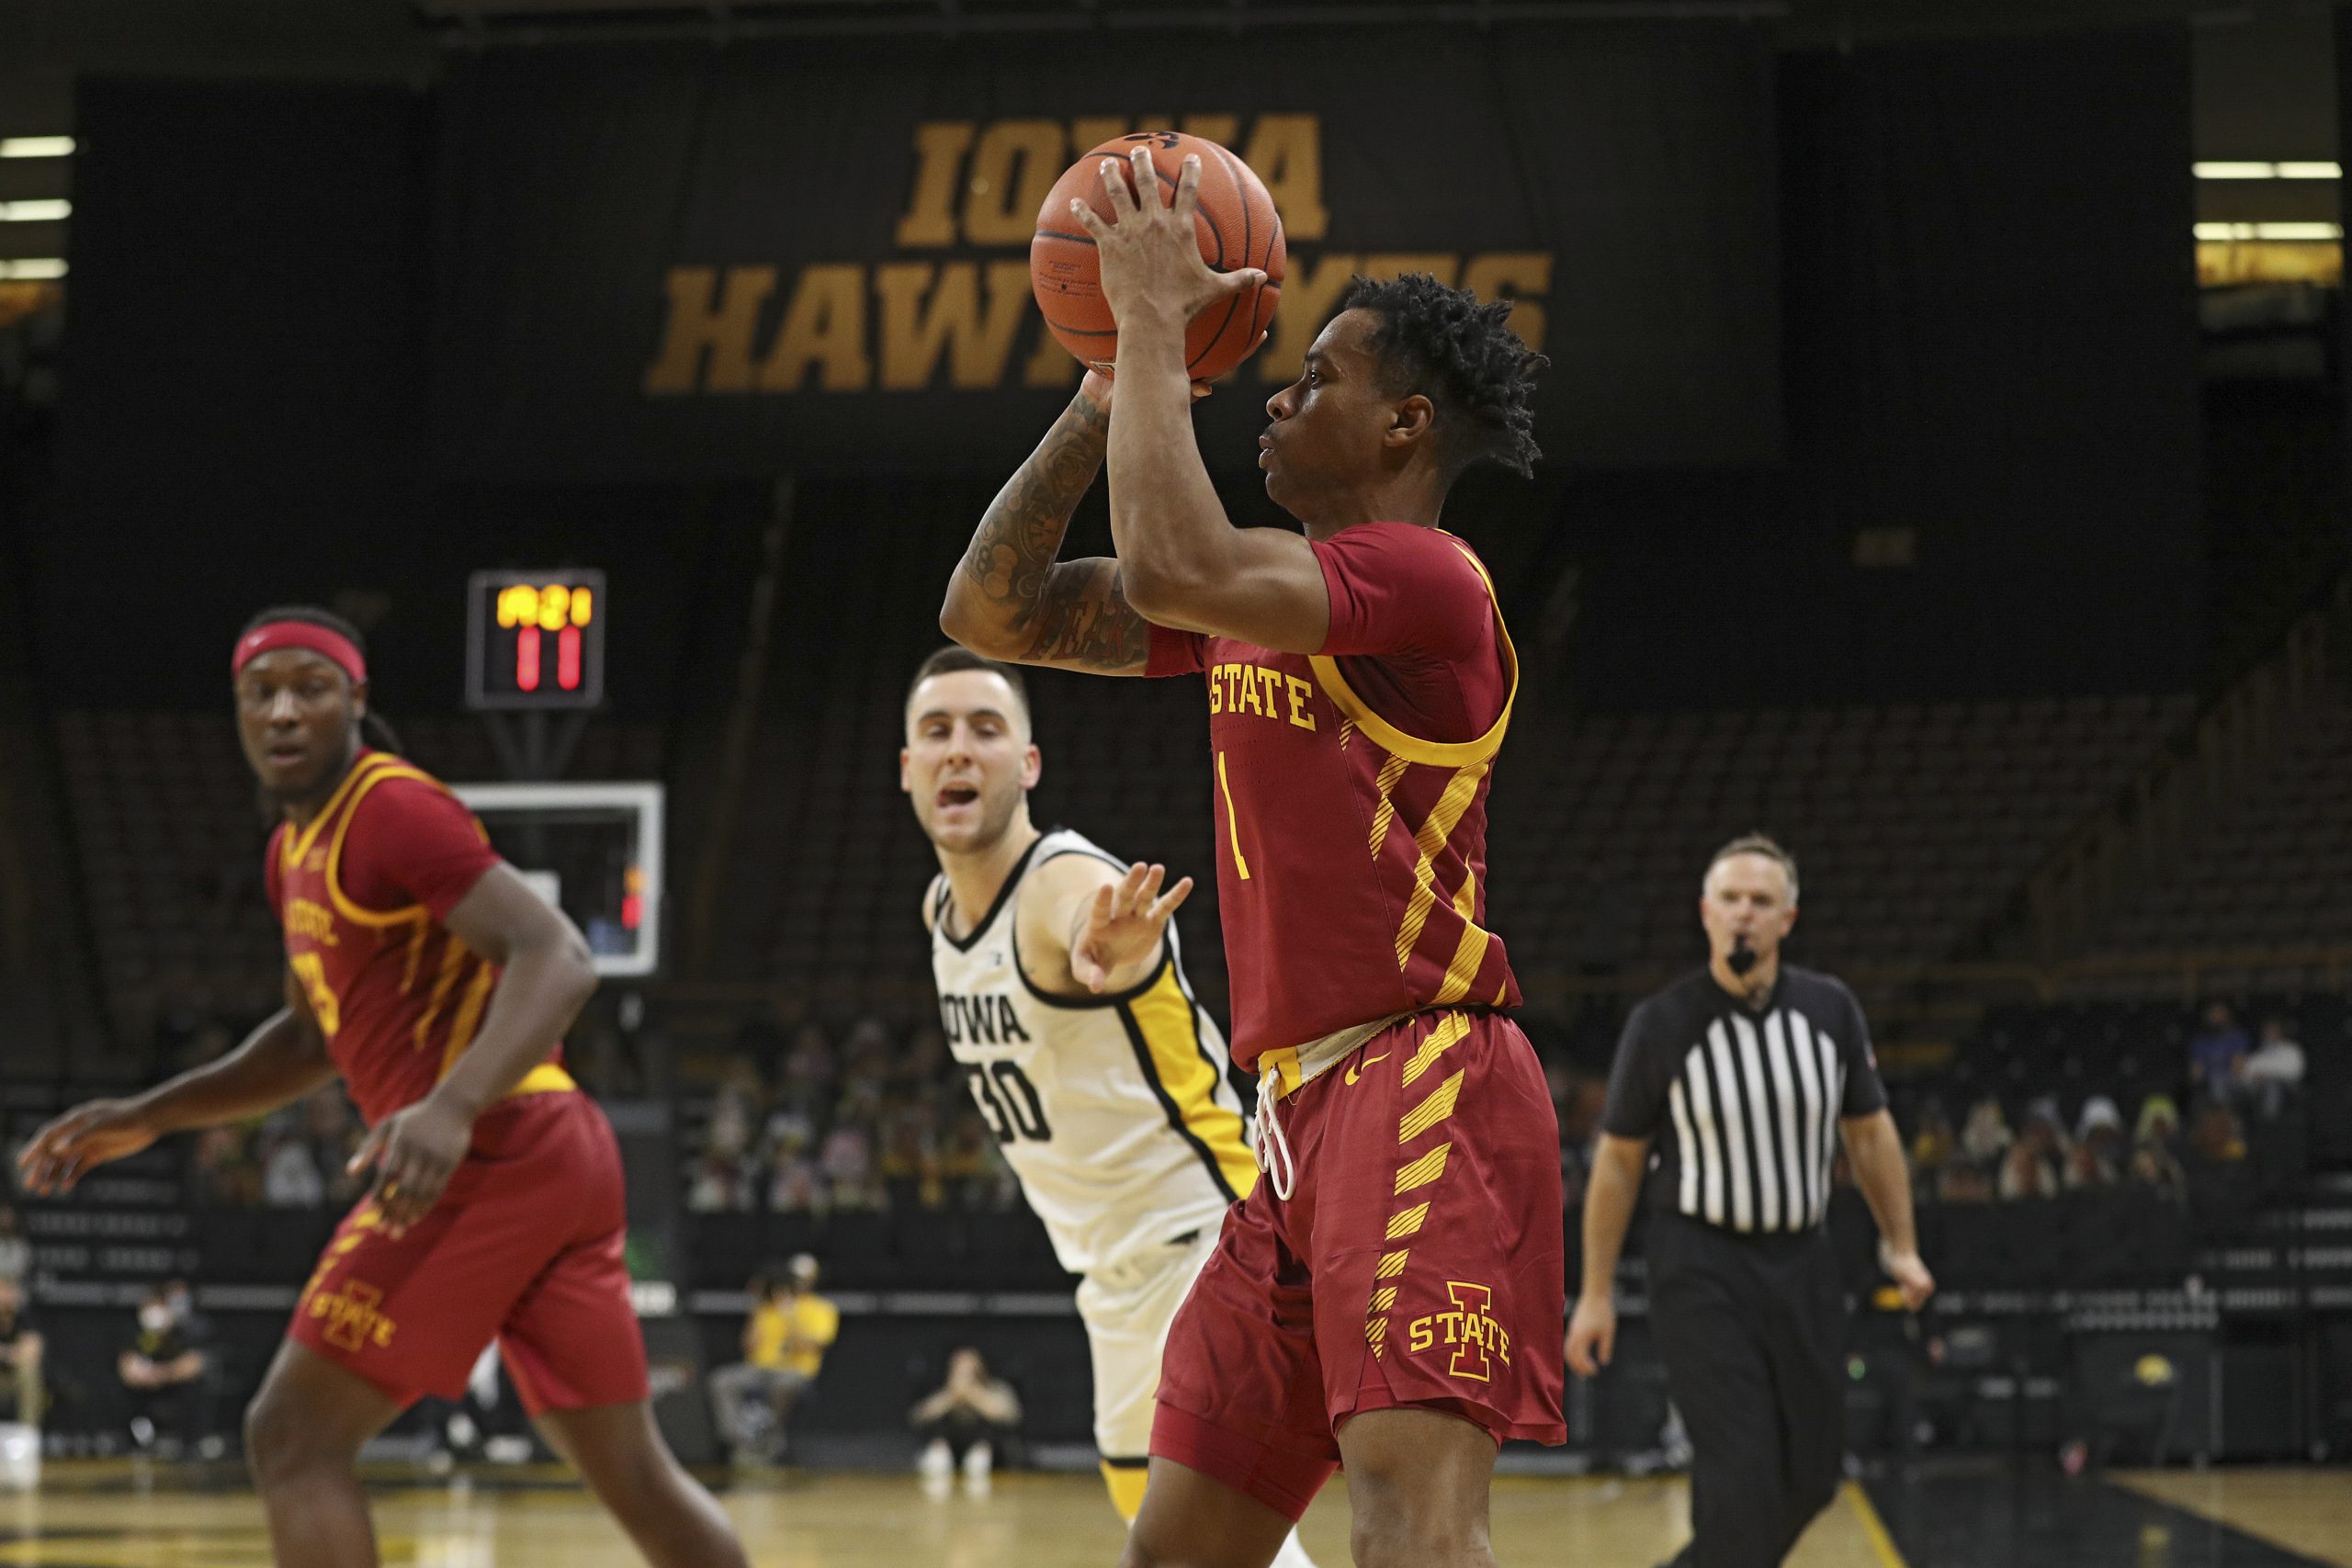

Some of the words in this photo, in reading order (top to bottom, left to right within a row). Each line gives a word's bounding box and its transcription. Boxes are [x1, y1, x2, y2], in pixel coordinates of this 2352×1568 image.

[895, 113, 1329, 248] IOA
[1212, 664, 1316, 731] STATE
[1218, 751, 1250, 880] 1
[940, 994, 1031, 1044] OWA
[1409, 1312, 1510, 1368] STATE
